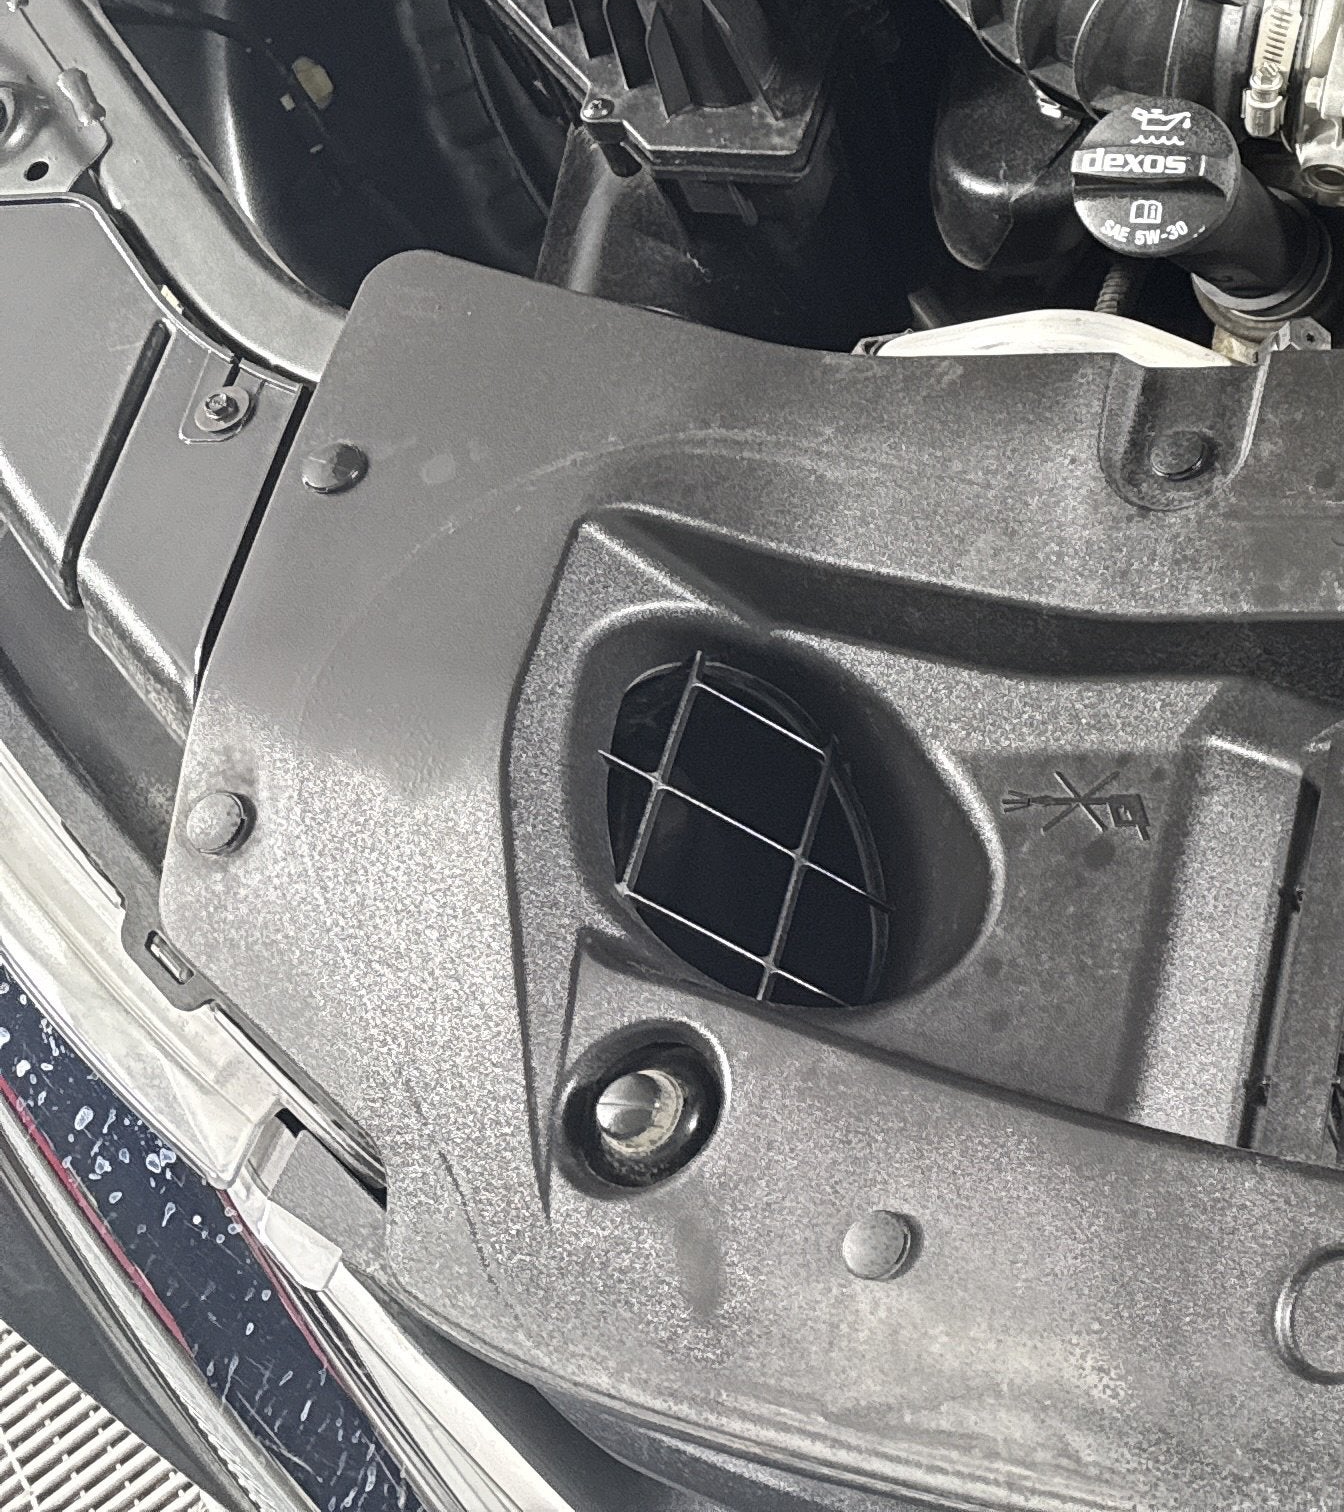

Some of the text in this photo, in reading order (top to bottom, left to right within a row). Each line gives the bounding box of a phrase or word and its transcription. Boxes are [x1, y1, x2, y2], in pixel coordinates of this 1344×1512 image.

[1082, 148, 1187, 174] dexos
[1100, 219, 1188, 244] SAE 5W-30
